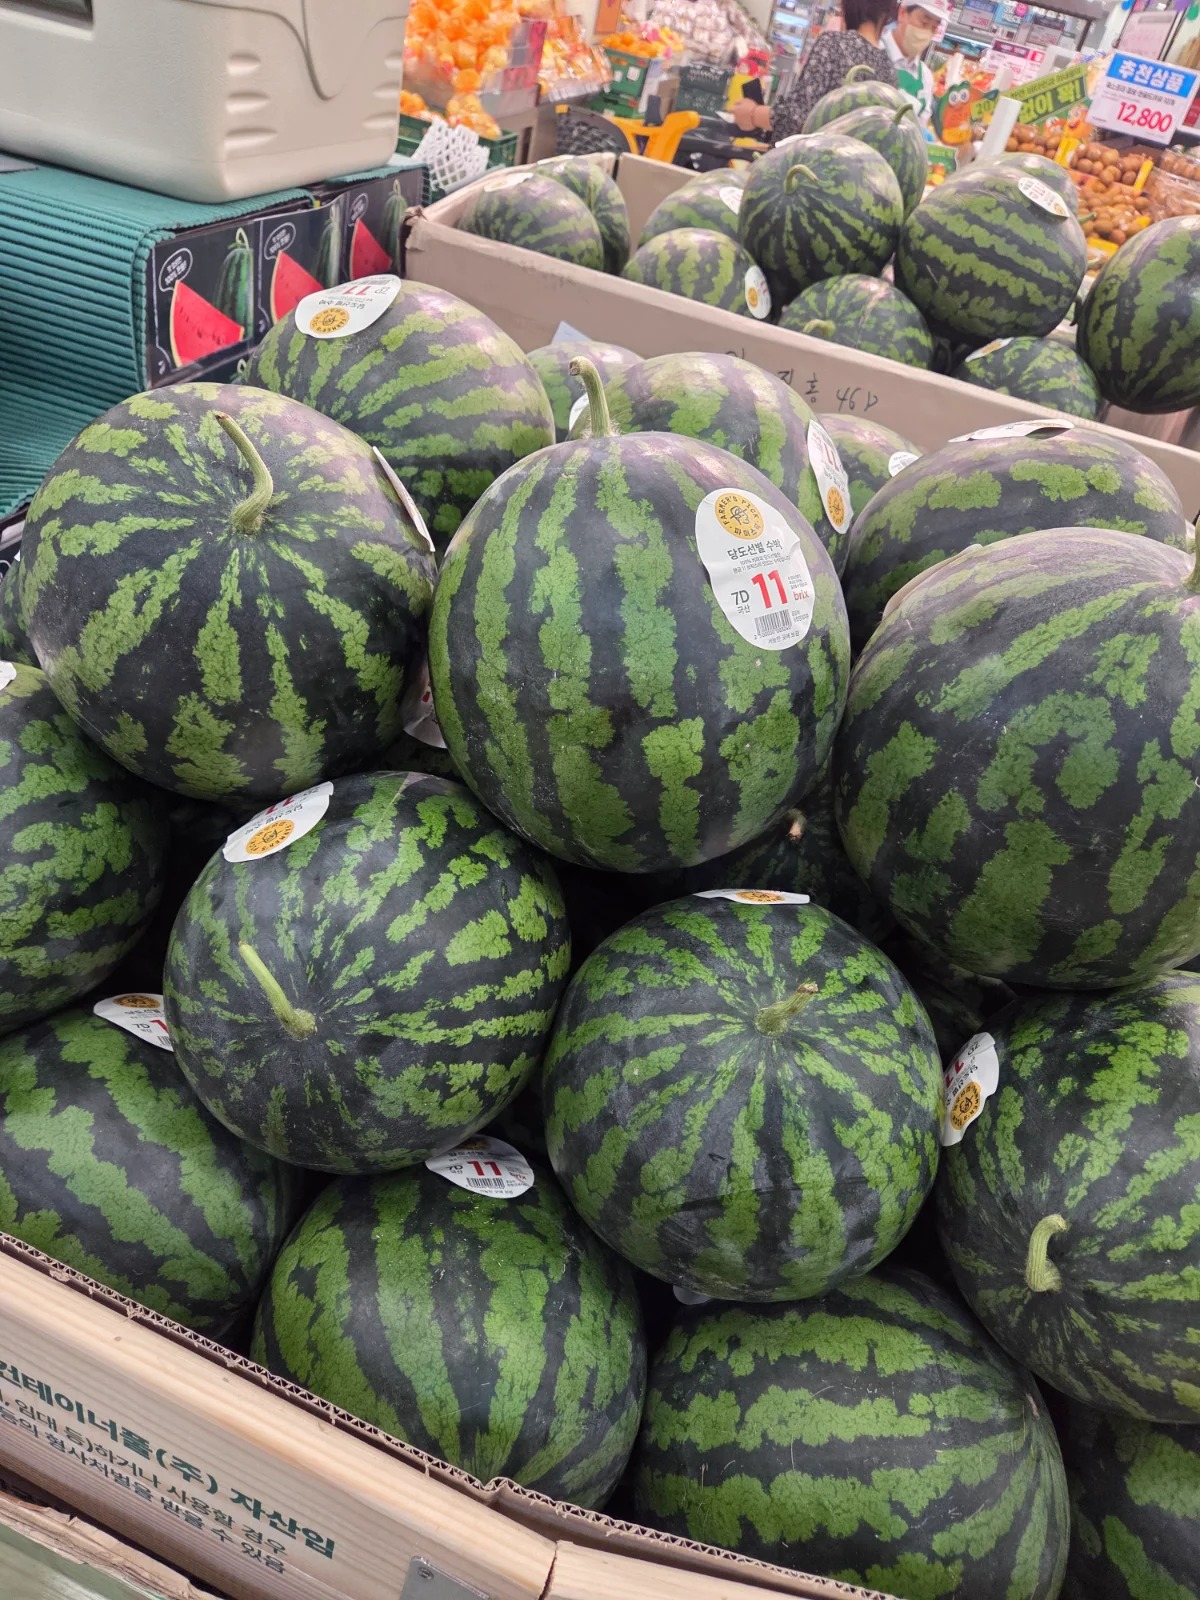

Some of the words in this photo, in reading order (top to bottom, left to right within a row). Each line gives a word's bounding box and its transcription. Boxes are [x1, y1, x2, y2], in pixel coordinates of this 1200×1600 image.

[1118, 59, 1185, 93] 추천상품
[1116, 101, 1173, 133] 12,800
[718, 495, 738, 526] FARMER'S
[741, 499, 761, 519] PICK
[727, 541, 766, 561] 당도선별
[766, 539, 783, 551] 수박
[730, 589, 750, 606] 7D
[751, 569, 788, 609] 11
[793, 589, 809, 601] brix
[737, 603, 751, 614] 국산
[466, 1160, 502, 1176] 11
[15, 1398, 58, 1433] 임대
[64, 1426, 161, 1489] 등)하거나
[167, 1484, 236, 1530] 사용할
[242, 1525, 288, 1556] 경우
[45, 1431, 154, 1503] 형사처벌을
[160, 1494, 206, 1531] 받을
[211, 1527, 235, 1544] 수
[241, 1539, 286, 1575] 있음
[230, 1487, 336, 1560] 자산임
